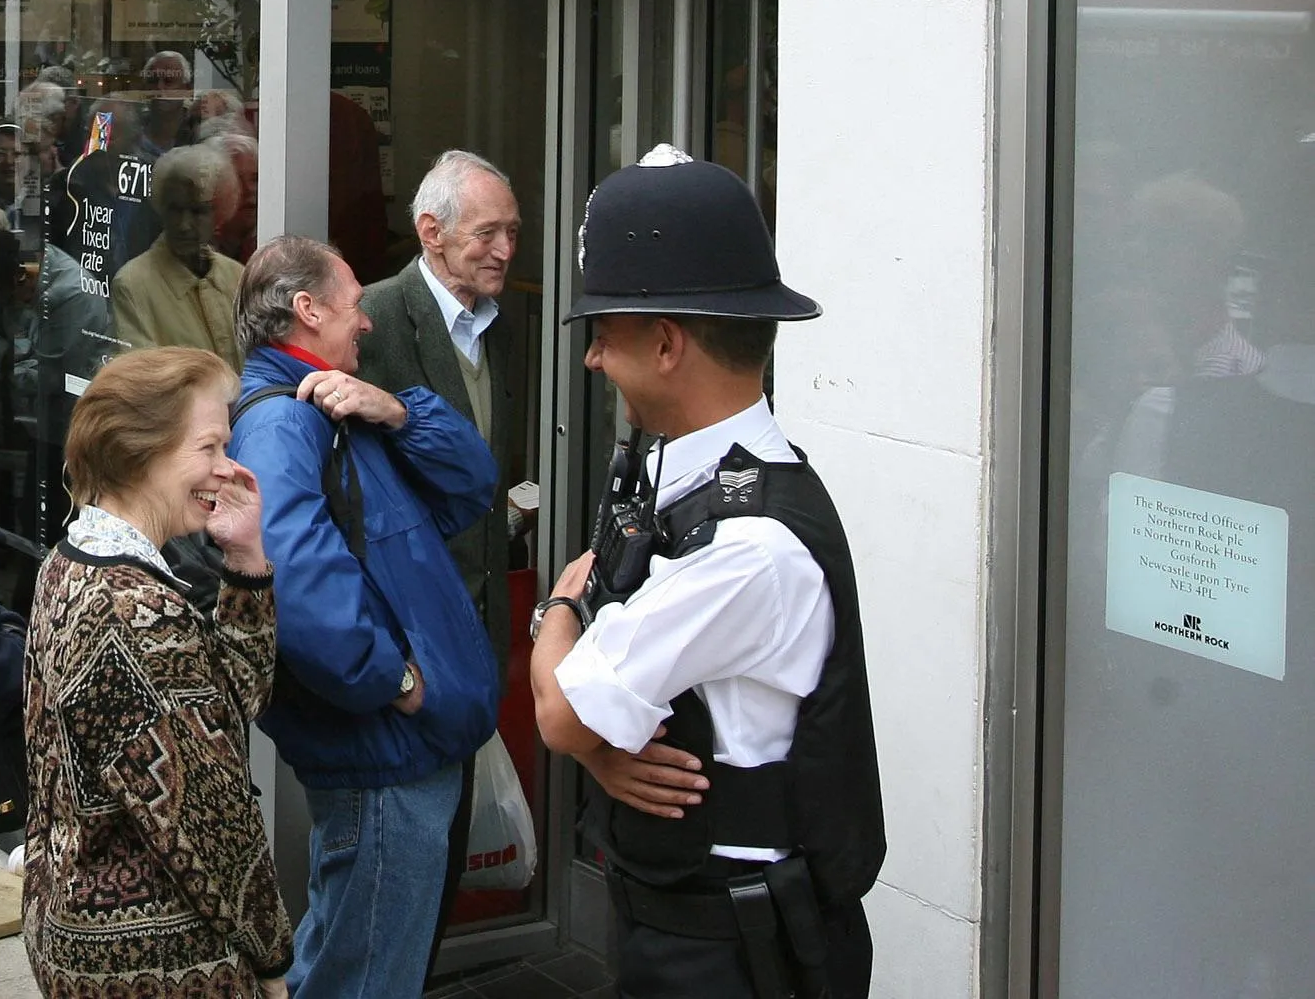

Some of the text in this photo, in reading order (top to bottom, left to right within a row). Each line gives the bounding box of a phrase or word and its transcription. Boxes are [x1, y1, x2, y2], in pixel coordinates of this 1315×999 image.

[335, 63, 381, 75] and loans
[82, 221, 110, 250] fixed
[80, 251, 104, 273] rate
[80, 267, 110, 298] bond
[1134, 495, 1260, 536] The Registered Office of
[1147, 513, 1244, 547] Northern Rock plc
[1132, 526, 1259, 566] is Northern Rock House
[1170, 548, 1217, 571] Gosforth
[1139, 555, 1250, 595] Newcastle upon Tyne
[1170, 578, 1218, 601] NE3 4PL
[1154, 620, 1231, 651] NORTHERN ROCK
